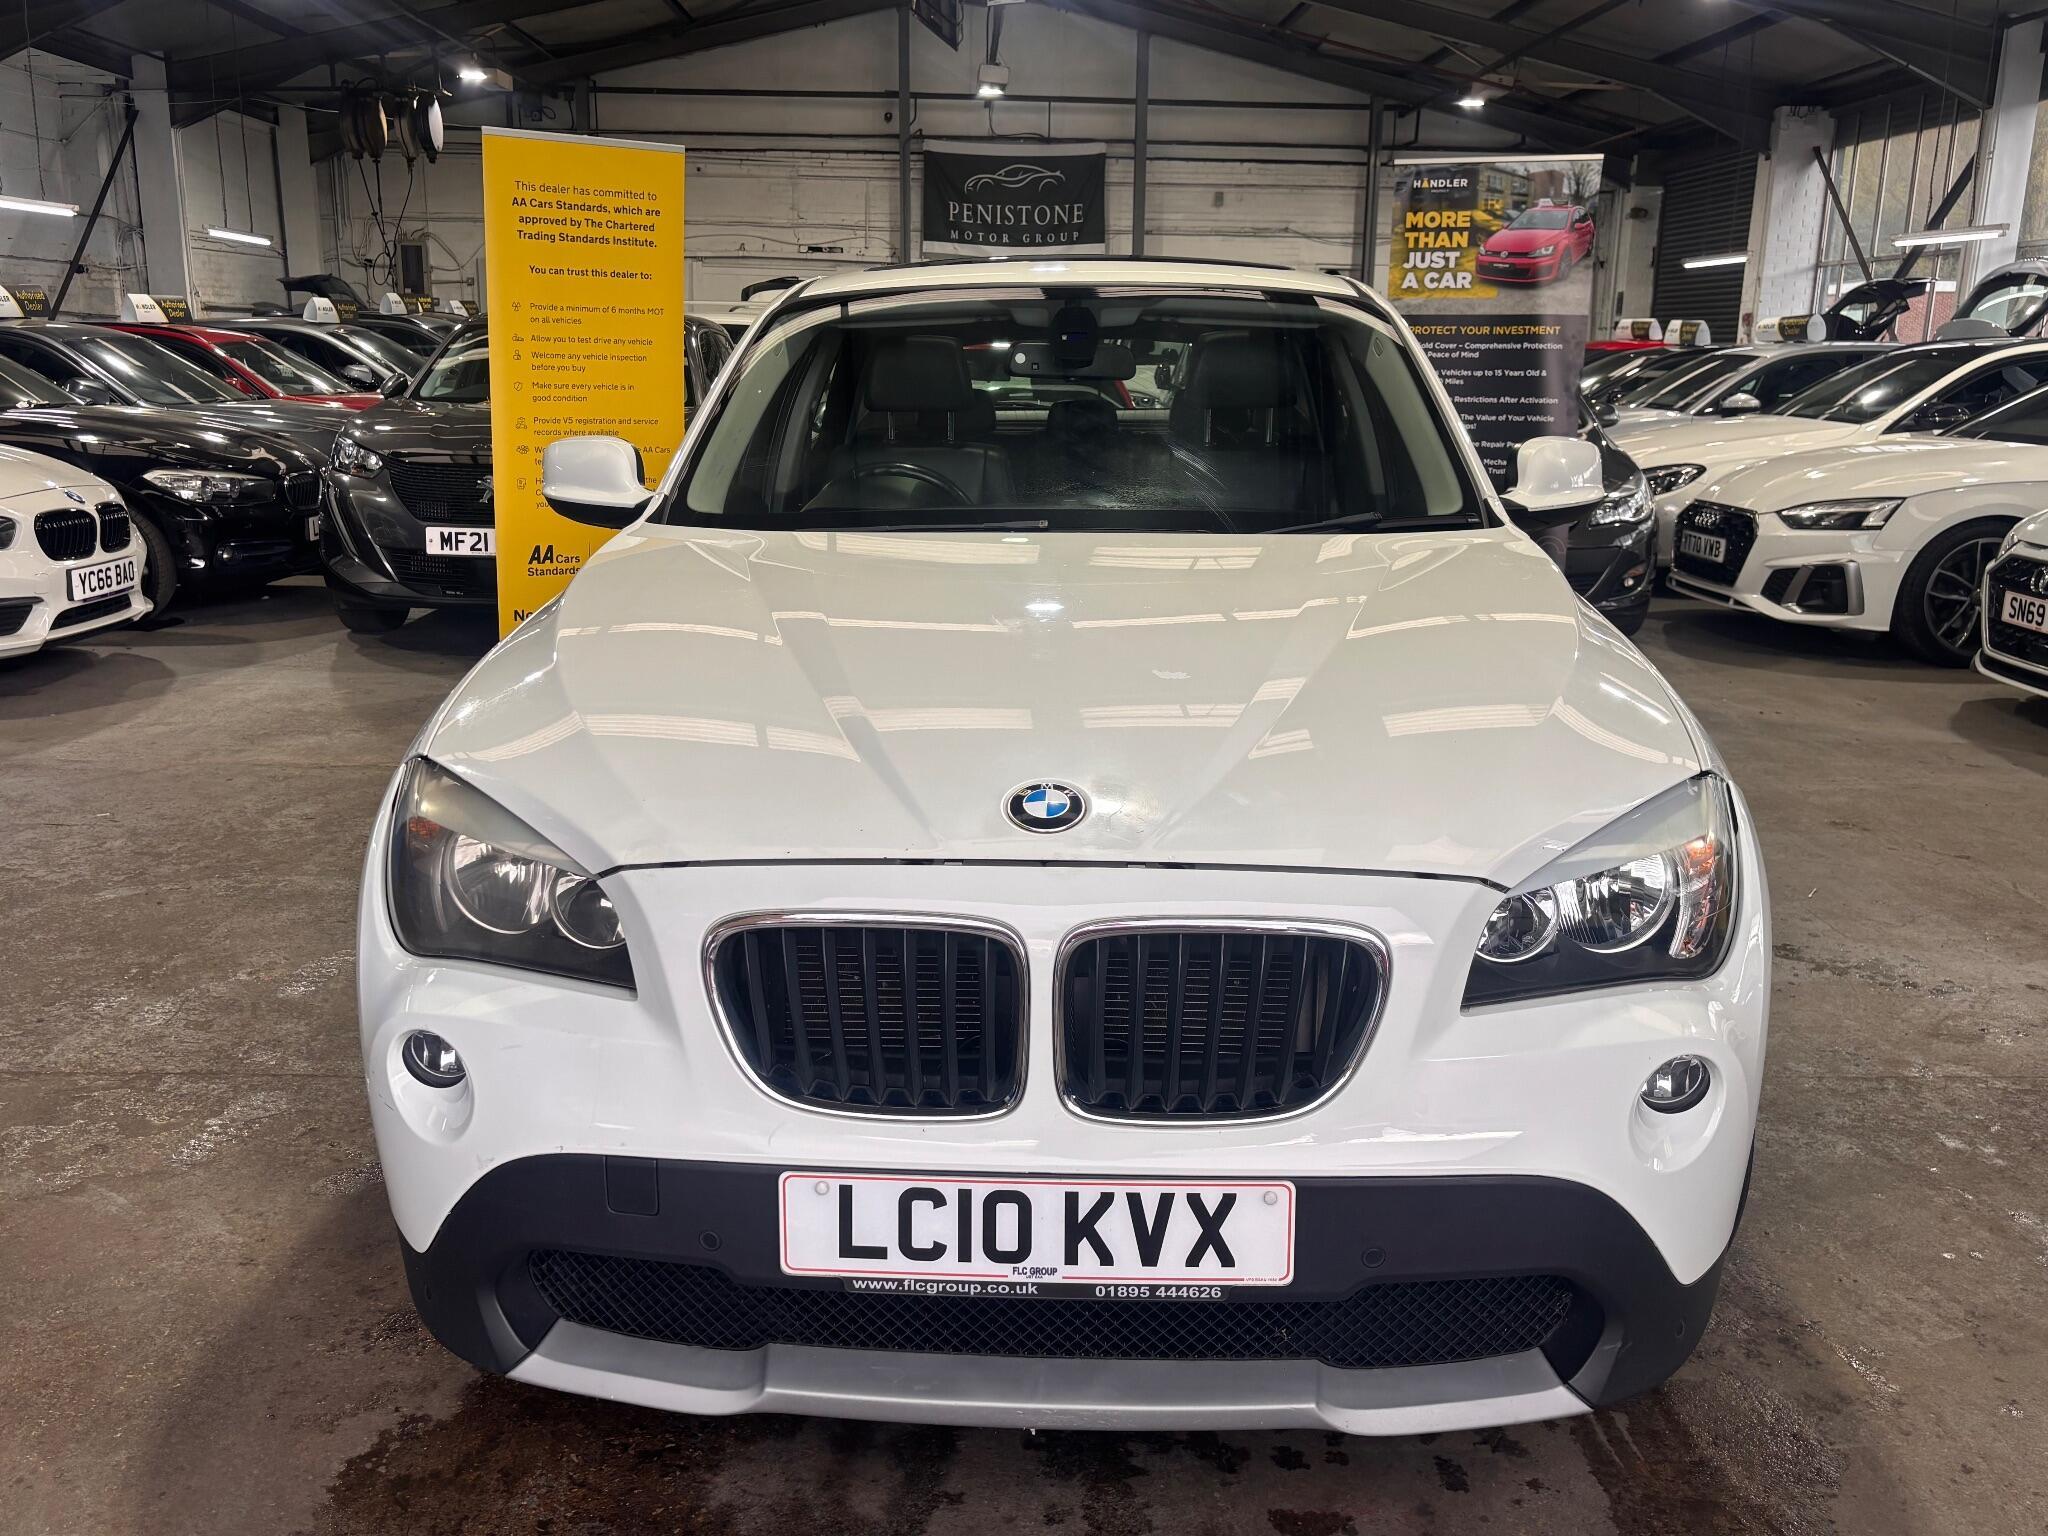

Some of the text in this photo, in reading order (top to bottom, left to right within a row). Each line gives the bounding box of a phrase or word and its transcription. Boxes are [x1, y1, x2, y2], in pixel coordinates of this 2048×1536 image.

[515, 181, 658, 201] This dealer has committed to
[512, 197, 660, 217] AA Cars Standards, which are
[948, 201, 1084, 226] PENISTONE
[518, 216, 654, 232] approved by The Chartered
[1406, 211, 1472, 228] MORE
[517, 230, 656, 248] Trading Standards Institute.
[950, 230, 1079, 243] MOTOR GROUP
[1405, 232, 1468, 248] THAN
[1402, 252, 1460, 268] JUST
[529, 265, 546, 274] You
[548, 267, 564, 275] can
[567, 268, 588, 276] trust
[592, 269, 608, 278] this
[610, 270, 638, 279] dealer
[1401, 272, 1472, 288] A CAR
[530, 303, 558, 312] Provide
[566, 305, 600, 313] minimum
[552, 316, 582, 324] vehicles
[1410, 326, 1561, 335] PROTECT YOUR INVESTMENT
[553, 336, 566, 344] you
[1464, 342, 1521, 350] Comprehensive
[532, 352, 566, 360] Welcome
[610, 354, 646, 362] inspection
[572, 364, 586, 372] buy
[571, 383, 592, 391] every
[532, 394, 551, 402] good
[534, 416, 560, 424] Provide
[575, 417, 616, 426] registration
[440, 531, 488, 552] MF21
[528, 545, 580, 564] AA Cars
[79, 561, 134, 594] YC66 BAO
[528, 566, 580, 576] Standards
[2009, 596, 2046, 627] SN69
[839, 1184, 1237, 1268] LC10 KVX
[1013, 1266, 1058, 1276] FLC GROUP
[852, 1279, 1038, 1296] www.flcgroup.co.uk
[1096, 1286, 1222, 1298] 01895 444626
